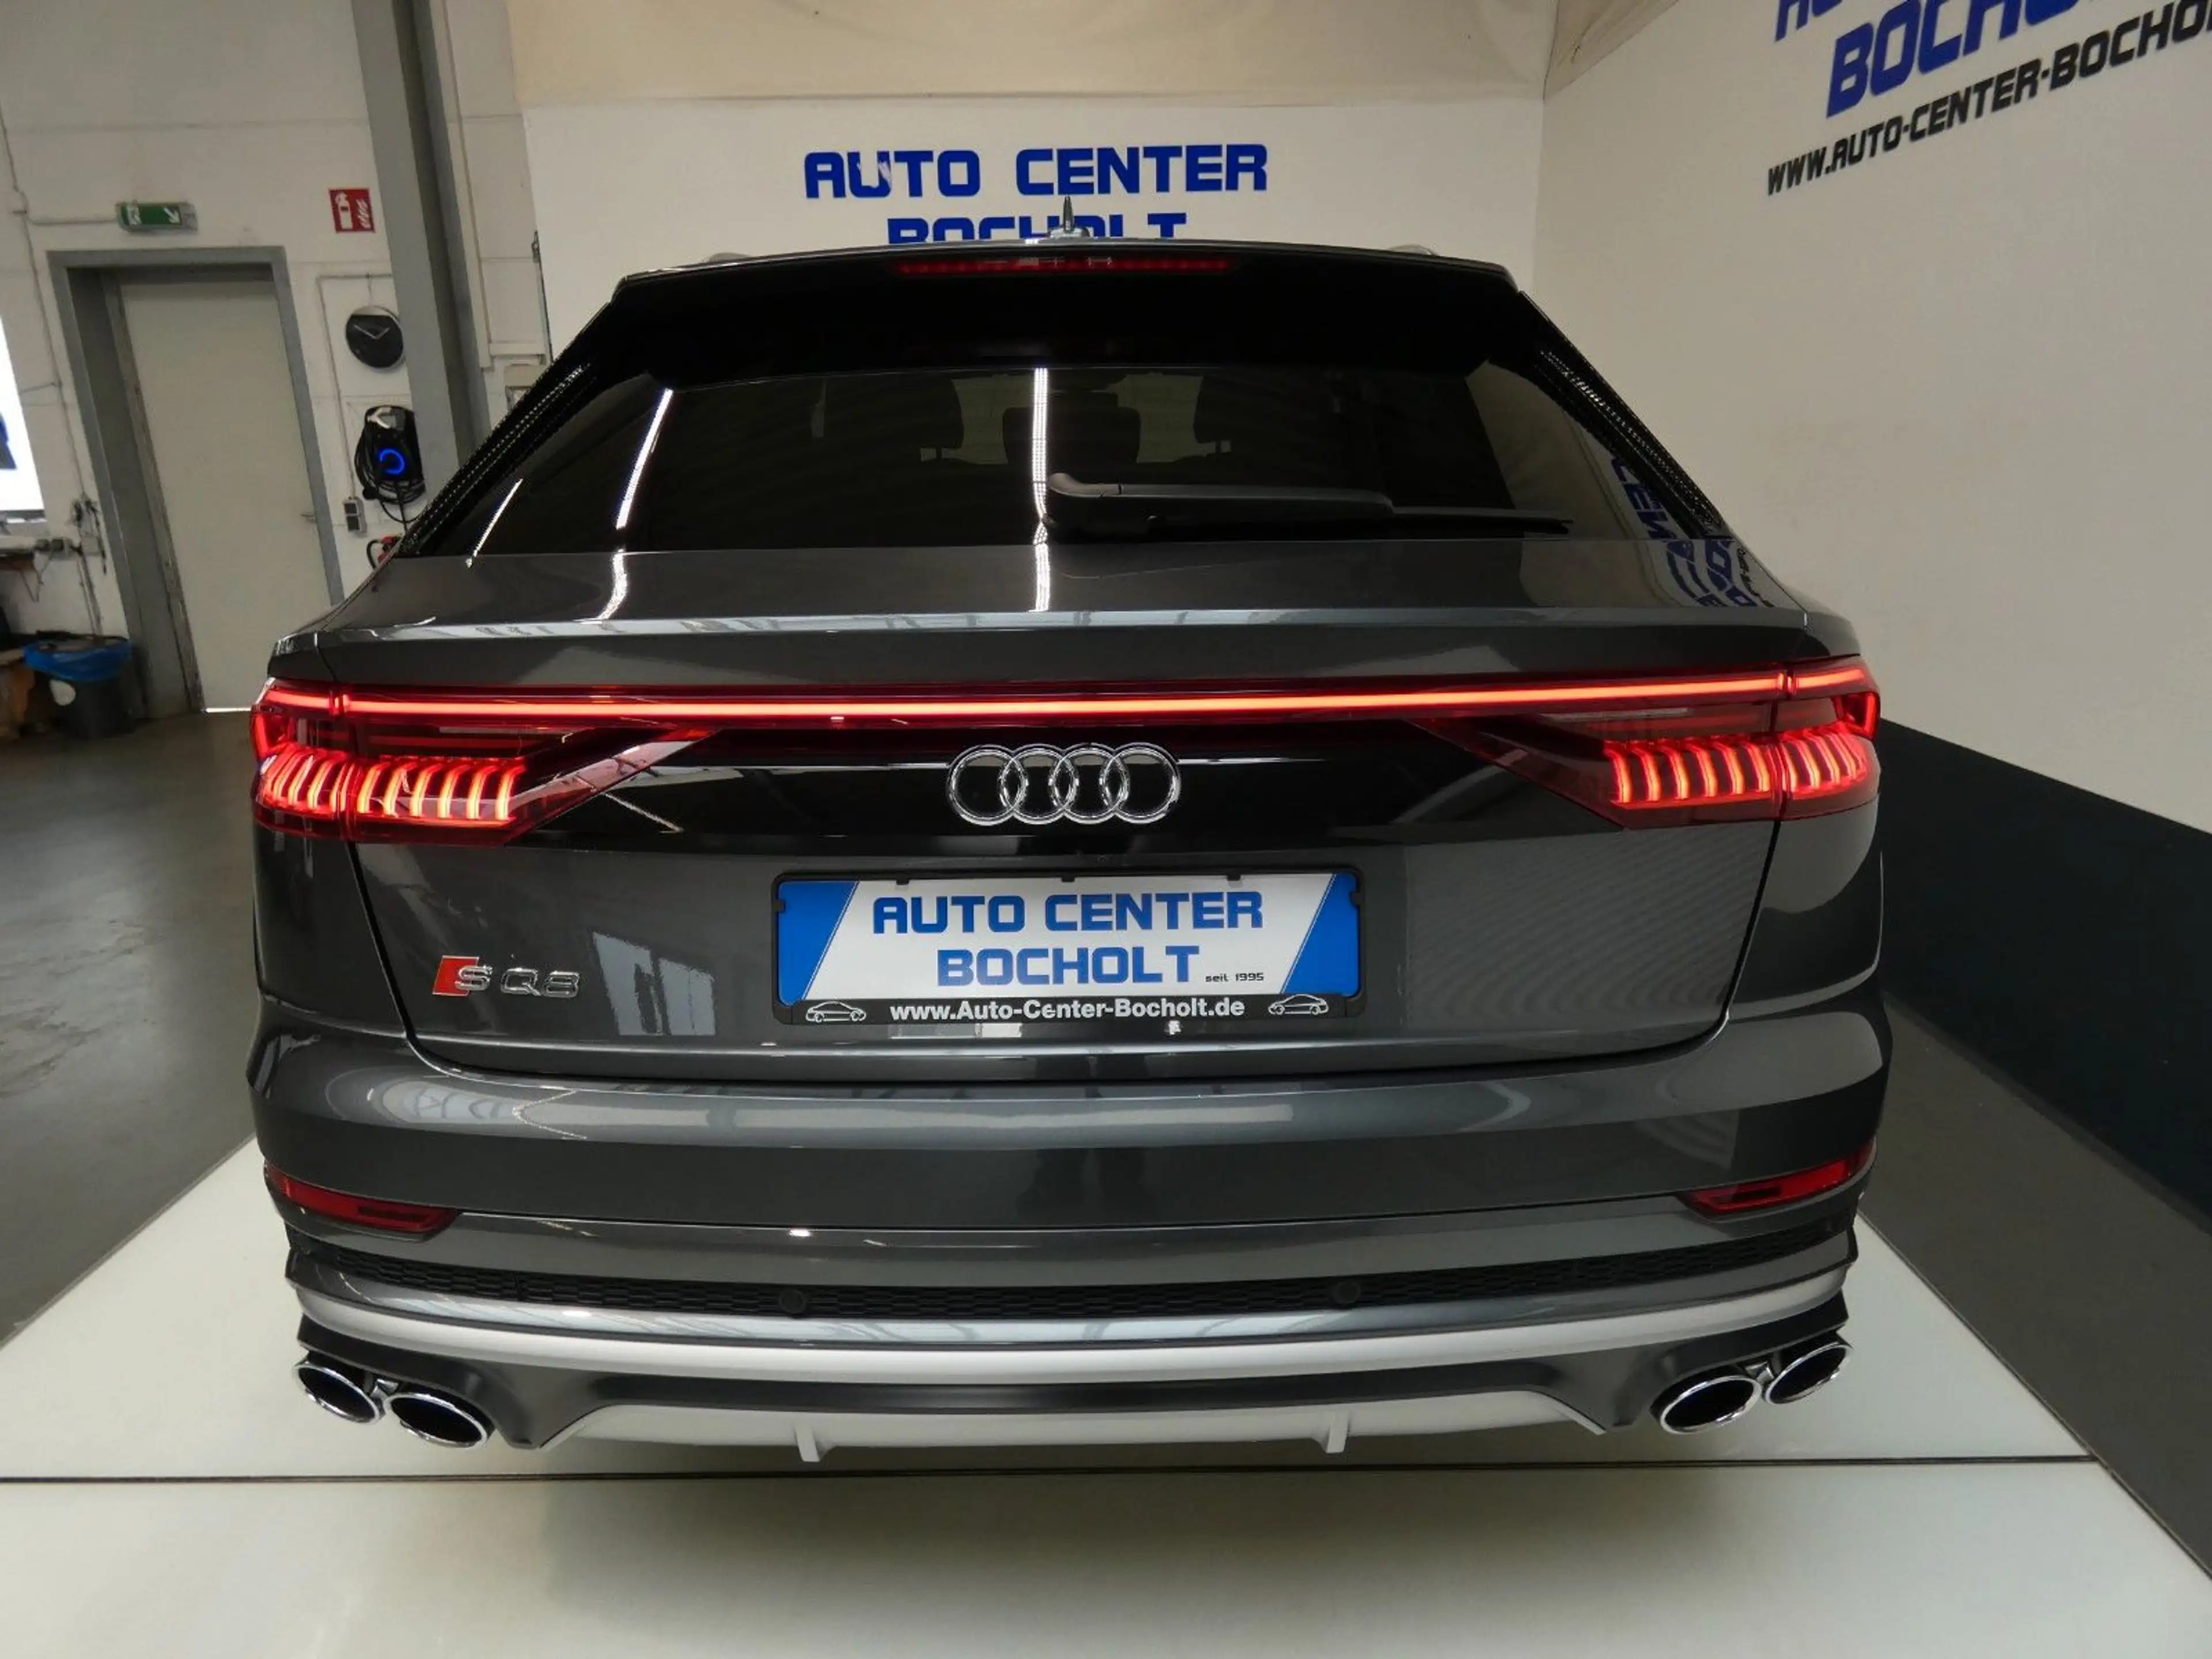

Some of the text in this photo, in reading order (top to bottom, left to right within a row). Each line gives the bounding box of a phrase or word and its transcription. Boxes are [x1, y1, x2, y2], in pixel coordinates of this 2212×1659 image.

[1826, 0, 2081, 118] BOCH
[1768, 0, 2212, 196] WWW.AUTO-CENTER-BOCHO
[804, 144, 1267, 199] AUTO CENTER
[873, 891, 1263, 935] AUTO CENTER
[937, 945, 1200, 986] BOCHOLT
[1205, 972, 1264, 982] seit 1995
[890, 997, 1245, 1020] www.Auto-Center-Bocholt.de
